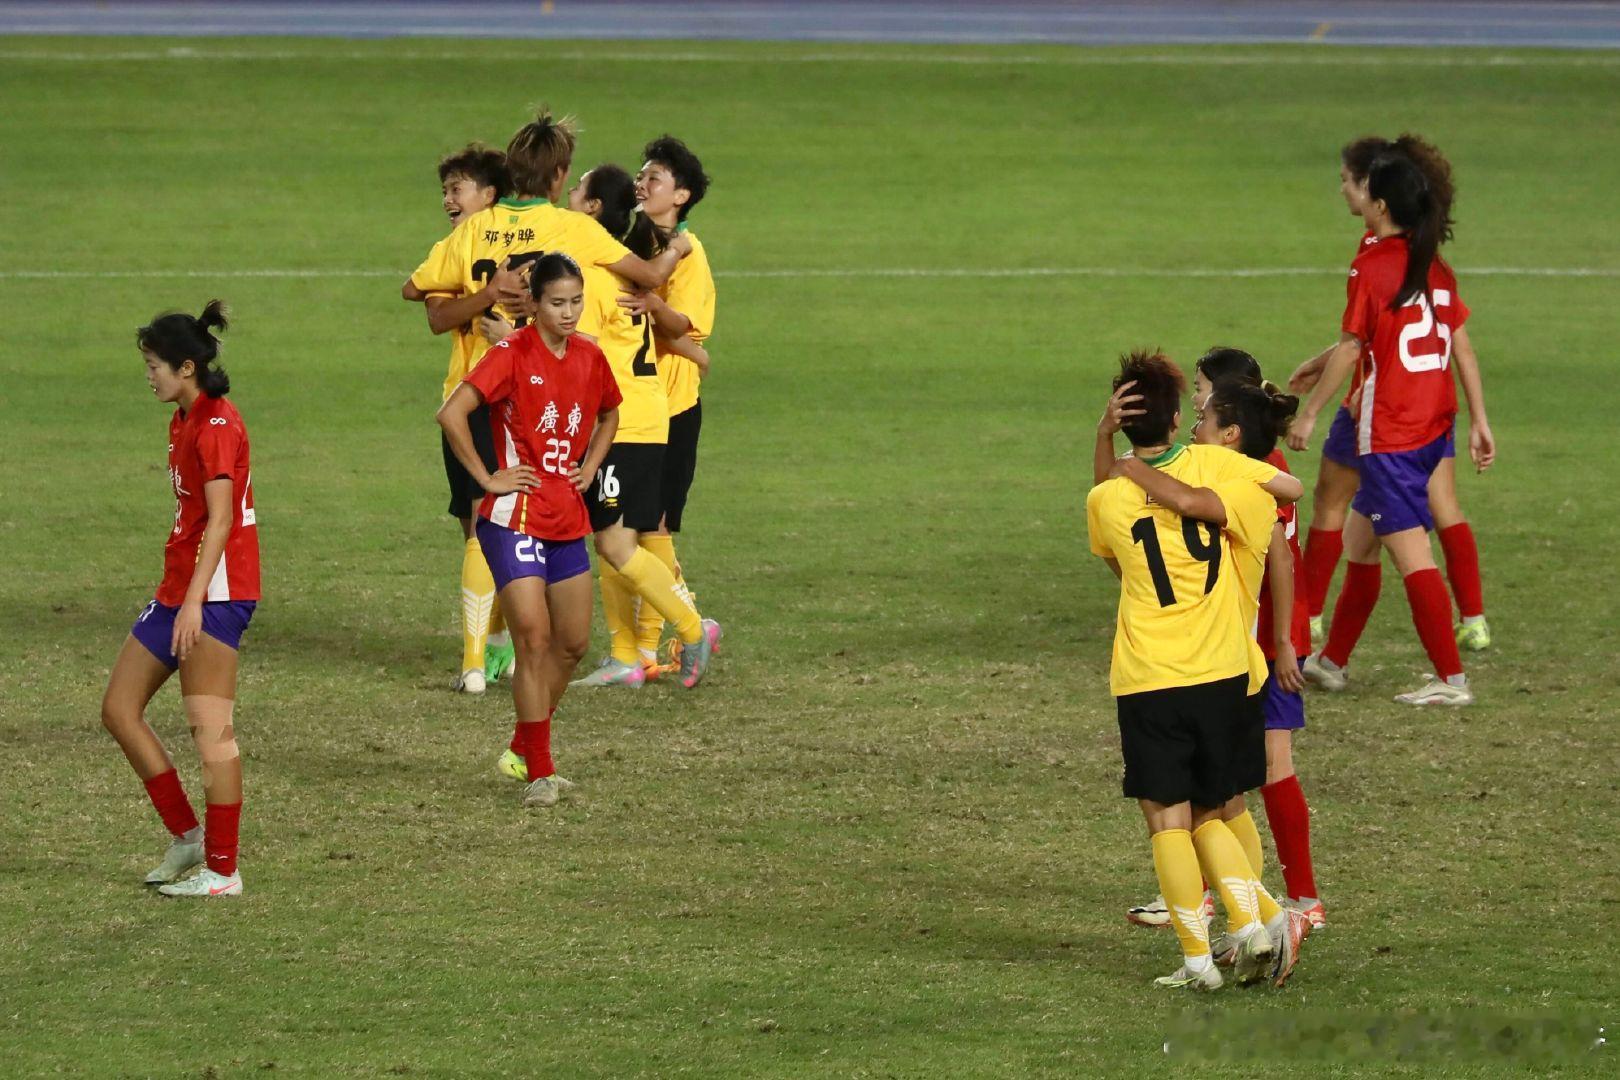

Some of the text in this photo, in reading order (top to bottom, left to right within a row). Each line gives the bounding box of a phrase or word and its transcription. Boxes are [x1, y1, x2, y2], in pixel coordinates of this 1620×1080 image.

[1399, 289, 1451, 372] 25
[535, 401, 582, 437] 廣東
[543, 438, 571, 475] 22
[597, 465, 620, 502] 26
[1131, 516, 1222, 608] 19
